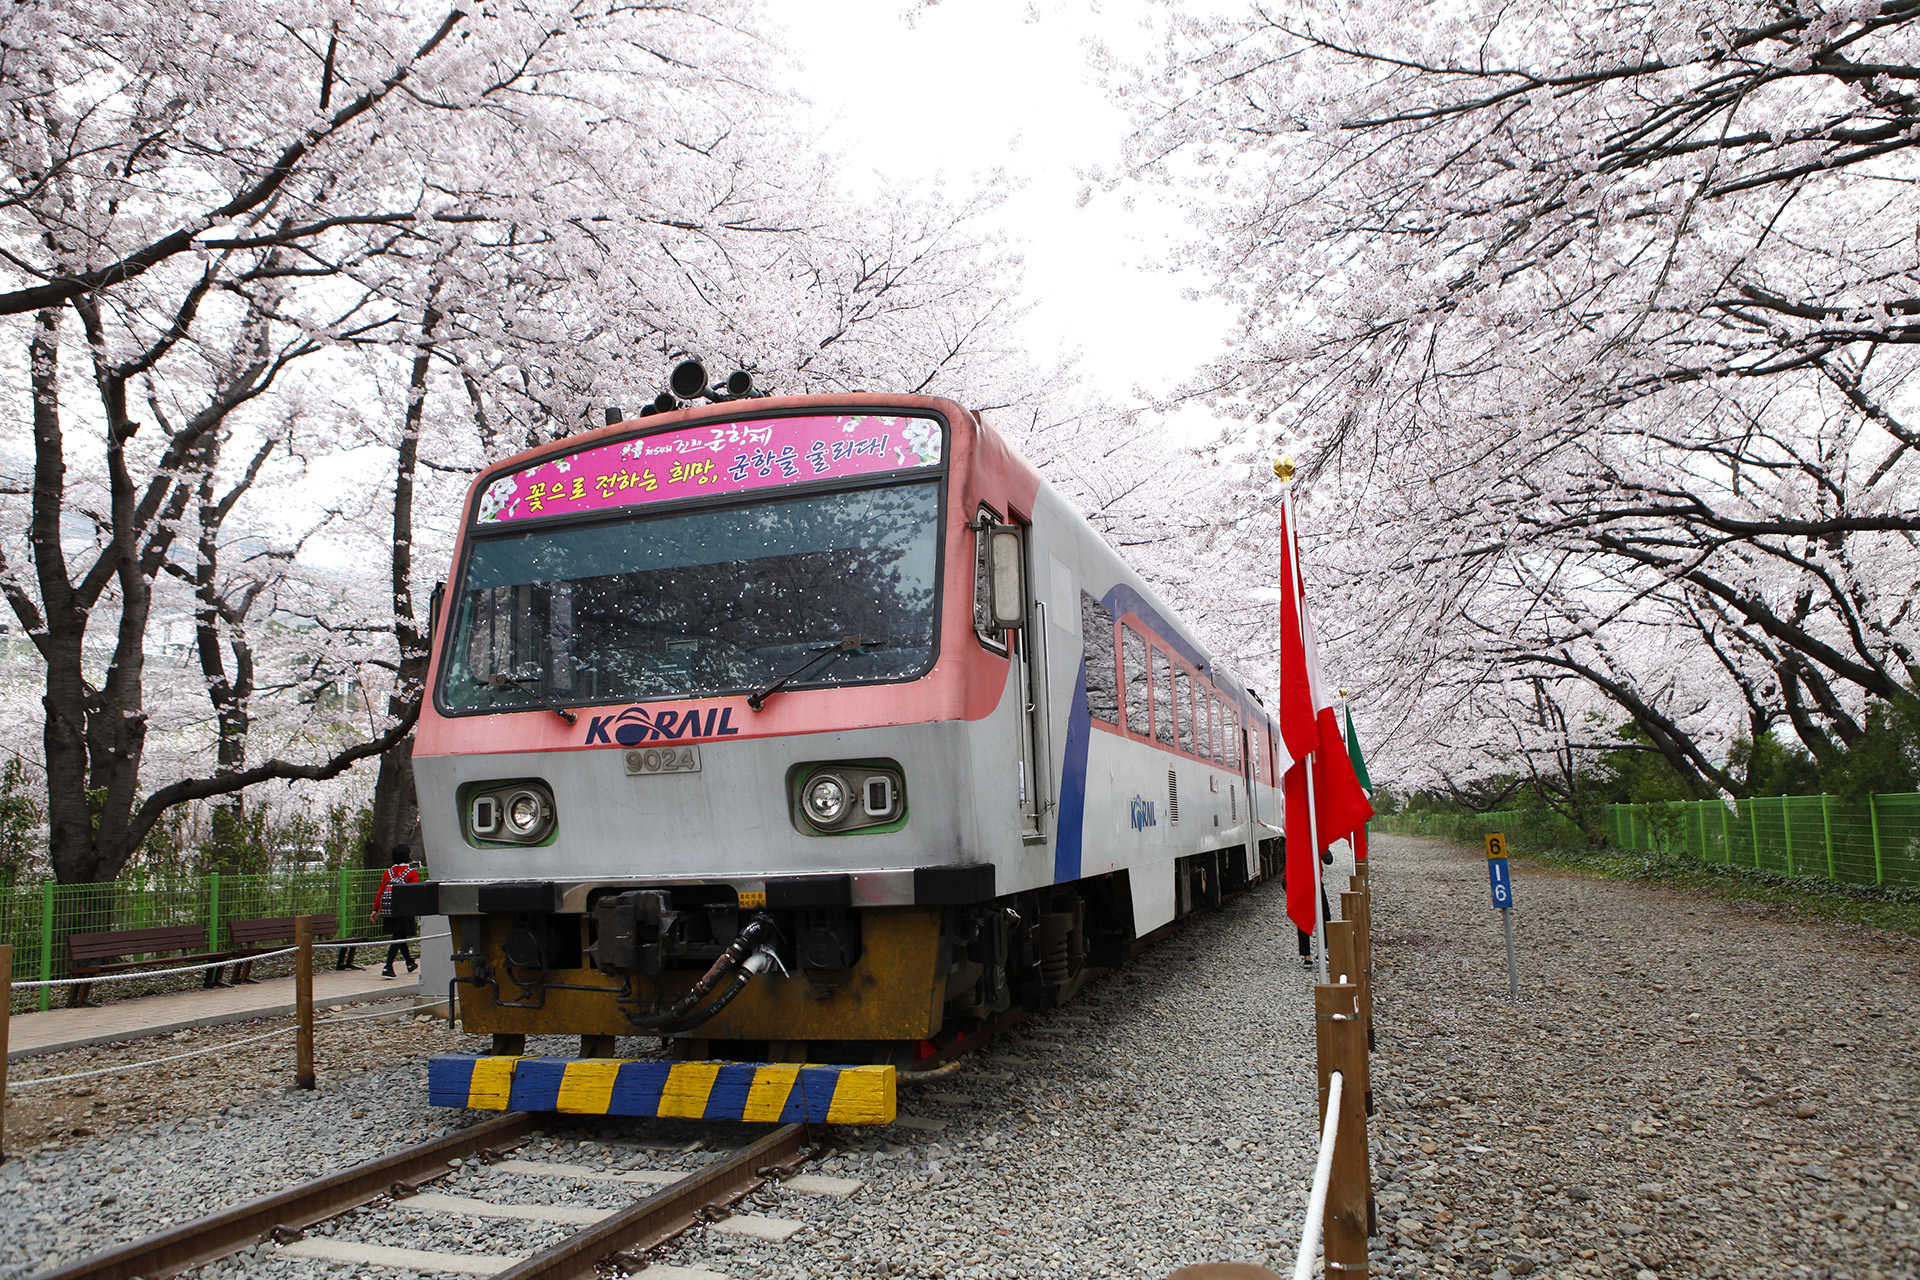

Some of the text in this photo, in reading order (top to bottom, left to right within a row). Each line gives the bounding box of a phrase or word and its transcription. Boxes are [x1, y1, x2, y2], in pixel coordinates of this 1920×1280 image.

[645, 423, 774, 456] 제54회 진해 군항제
[524, 435, 889, 512] 꽃으로 전하는 희망, 군항을 울리다!
[585, 707, 739, 746] KORAIL
[626, 749, 695, 772] 9024
[1131, 794, 1157, 832] KORAIL
[1490, 838, 1501, 855] 6
